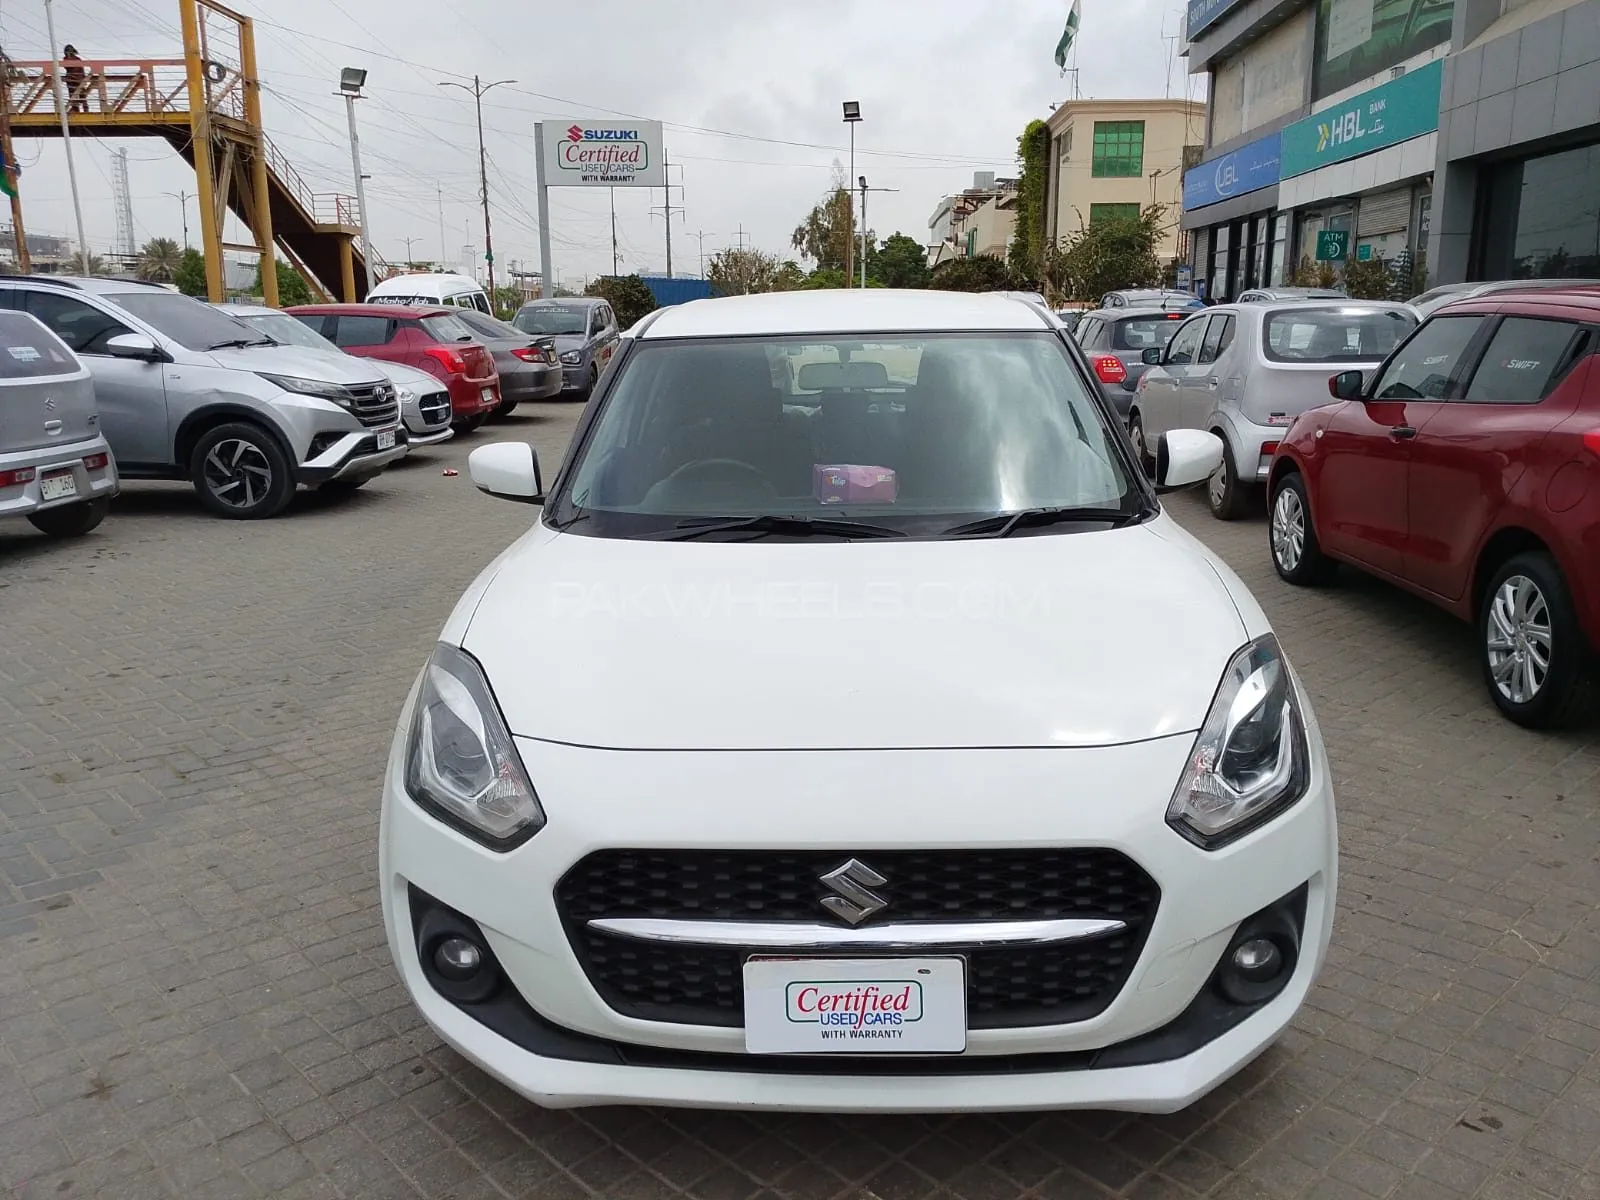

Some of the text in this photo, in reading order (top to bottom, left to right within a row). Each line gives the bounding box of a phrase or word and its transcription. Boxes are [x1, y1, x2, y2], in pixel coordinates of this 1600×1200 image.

[1369, 99, 1386, 114] BANK
[1330, 108, 1366, 147] HBL
[583, 130, 638, 140] SUZUKI
[565, 144, 640, 175] Certified
[581, 164, 635, 173] USED CARS
[1217, 163, 1239, 188] UBL
[1323, 232, 1344, 242] ATM
[1507, 359, 1540, 370] SWIFT
[797, 985, 910, 1030] Certified
[820, 1012, 903, 1025] USED CARS
[821, 1030, 903, 1039] WITH WARRANTY
